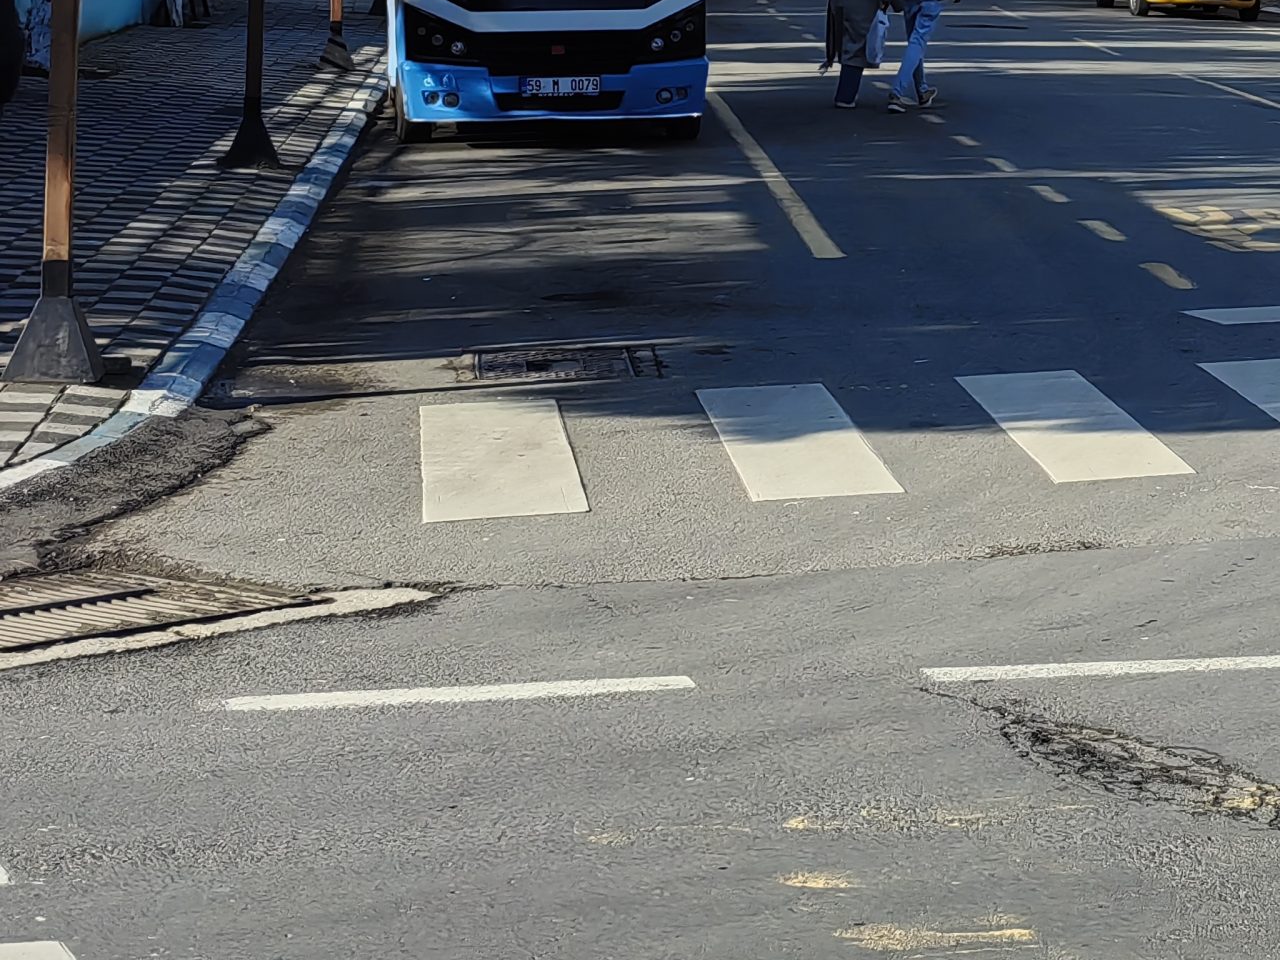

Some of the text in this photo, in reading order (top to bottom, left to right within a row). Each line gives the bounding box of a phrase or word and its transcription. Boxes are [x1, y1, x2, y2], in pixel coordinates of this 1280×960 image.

[527, 79, 599, 92] 59 M 0079
